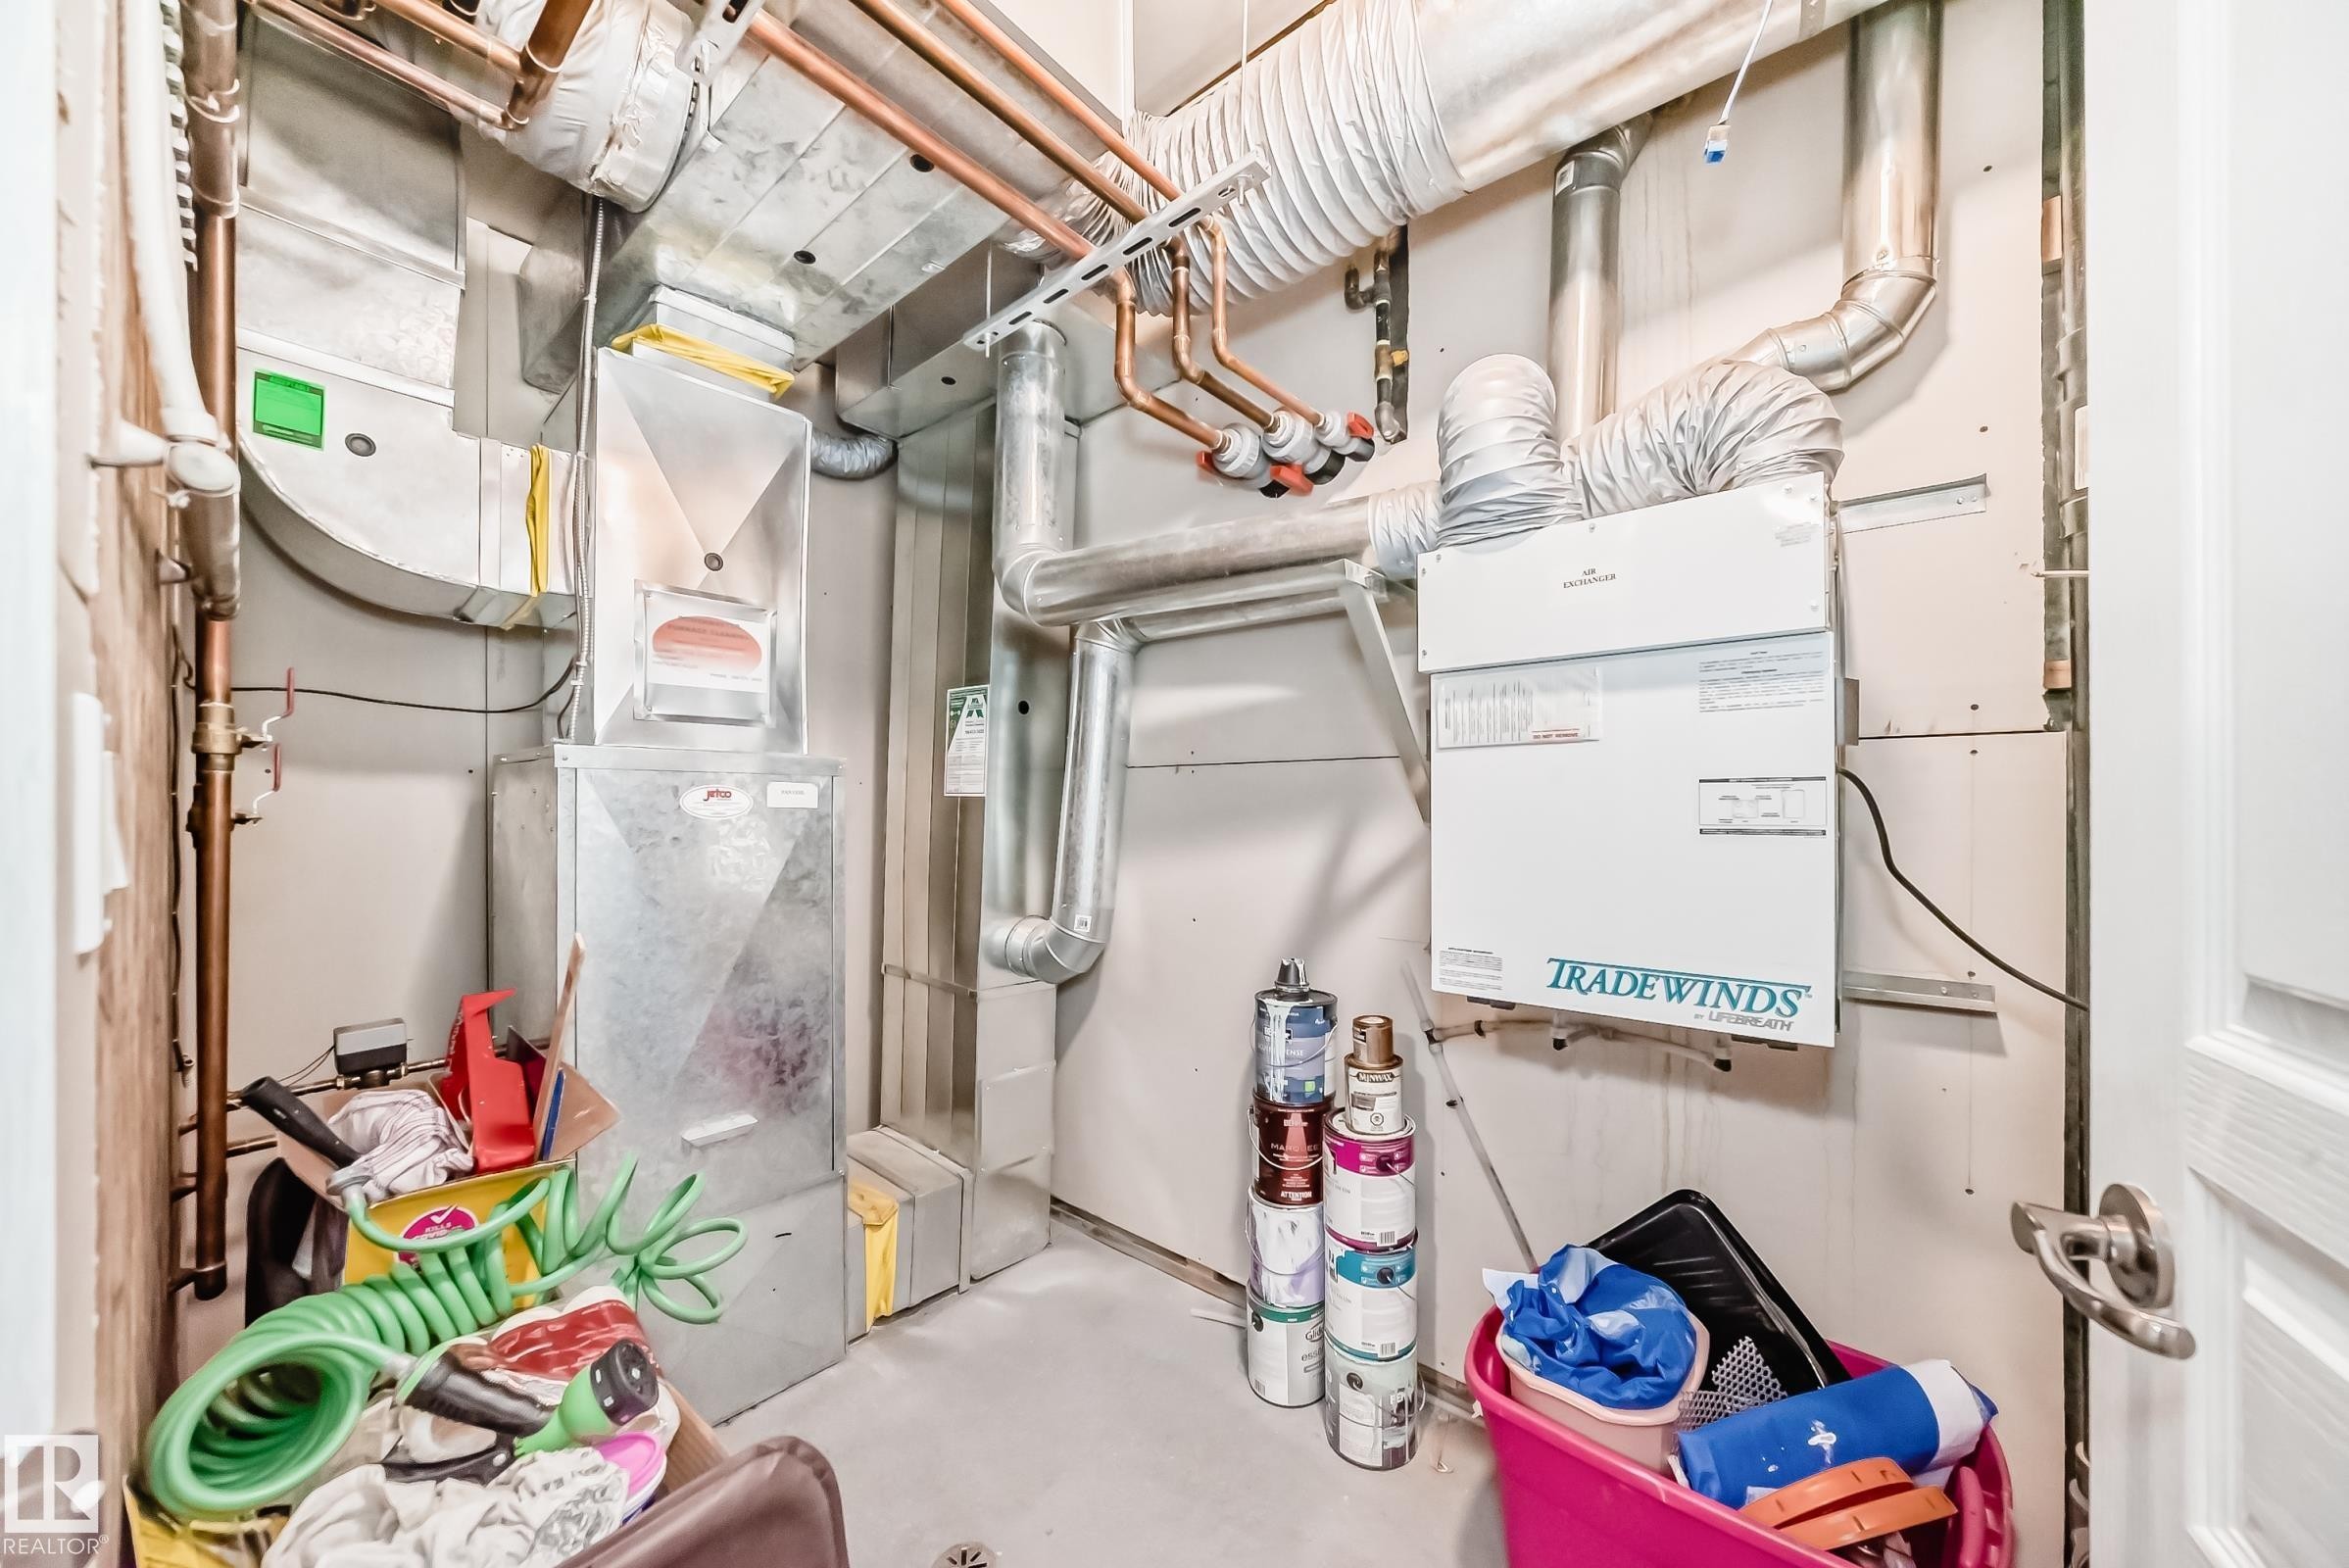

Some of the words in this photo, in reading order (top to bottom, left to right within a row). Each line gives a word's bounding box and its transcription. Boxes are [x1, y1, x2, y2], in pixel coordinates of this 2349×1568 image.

[1582, 567, 1596, 576] AIR
[1563, 573, 1616, 589] EXCHANGER
[703, 788, 732, 802] jetco
[1546, 957, 1812, 1017] TRADEWINDS
[1708, 1010, 1794, 1032] LIFEBREATH
[1358, 1072, 1393, 1082] MINWAX
[424, 1222, 452, 1233] KILLS
[1305, 1328, 1324, 1341] Glid
